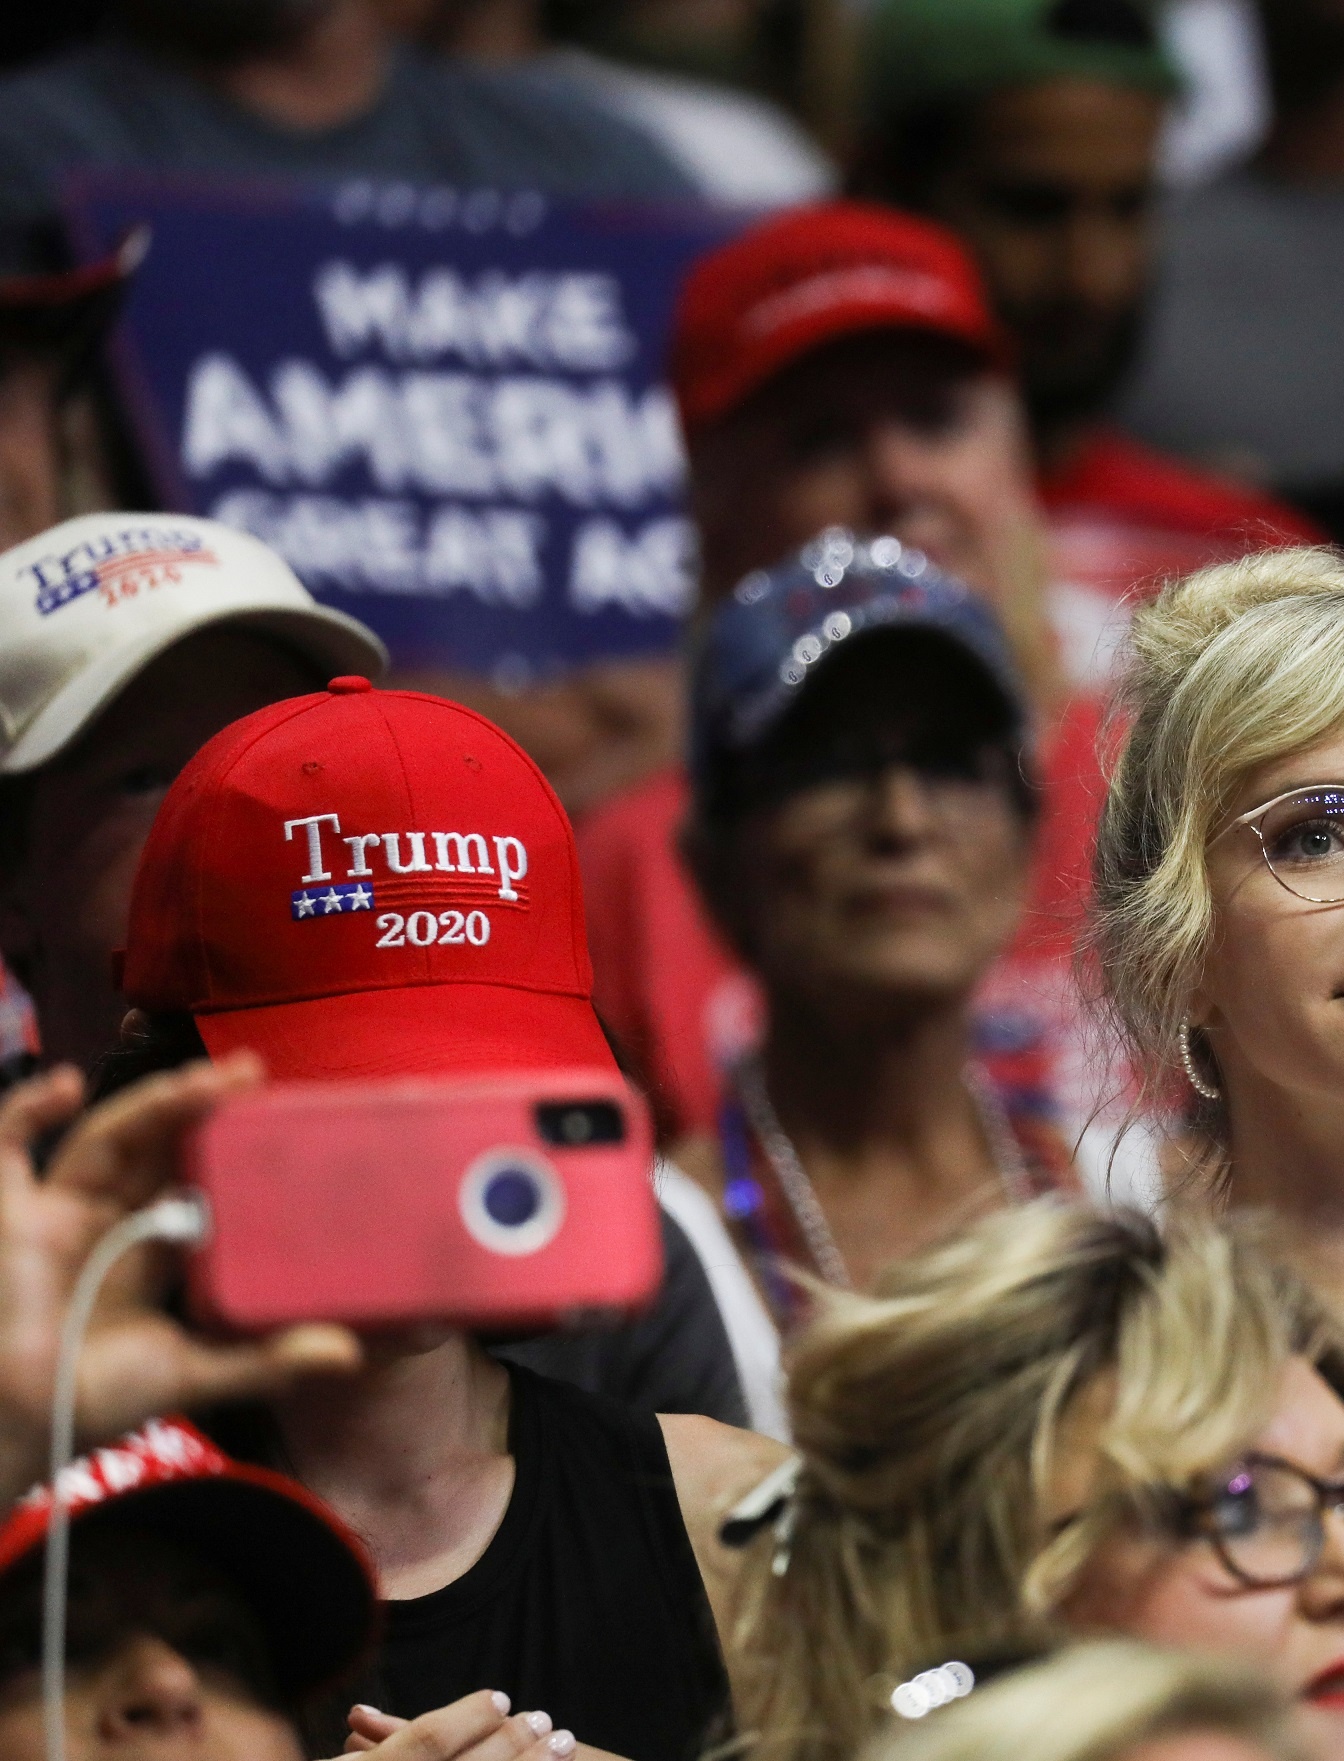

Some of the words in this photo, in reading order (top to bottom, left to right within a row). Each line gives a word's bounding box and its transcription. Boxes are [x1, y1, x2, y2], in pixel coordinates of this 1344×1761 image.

[317, 262, 634, 370] MAKE
[284, 813, 528, 902] Trump
[375, 910, 491, 948] 2020
